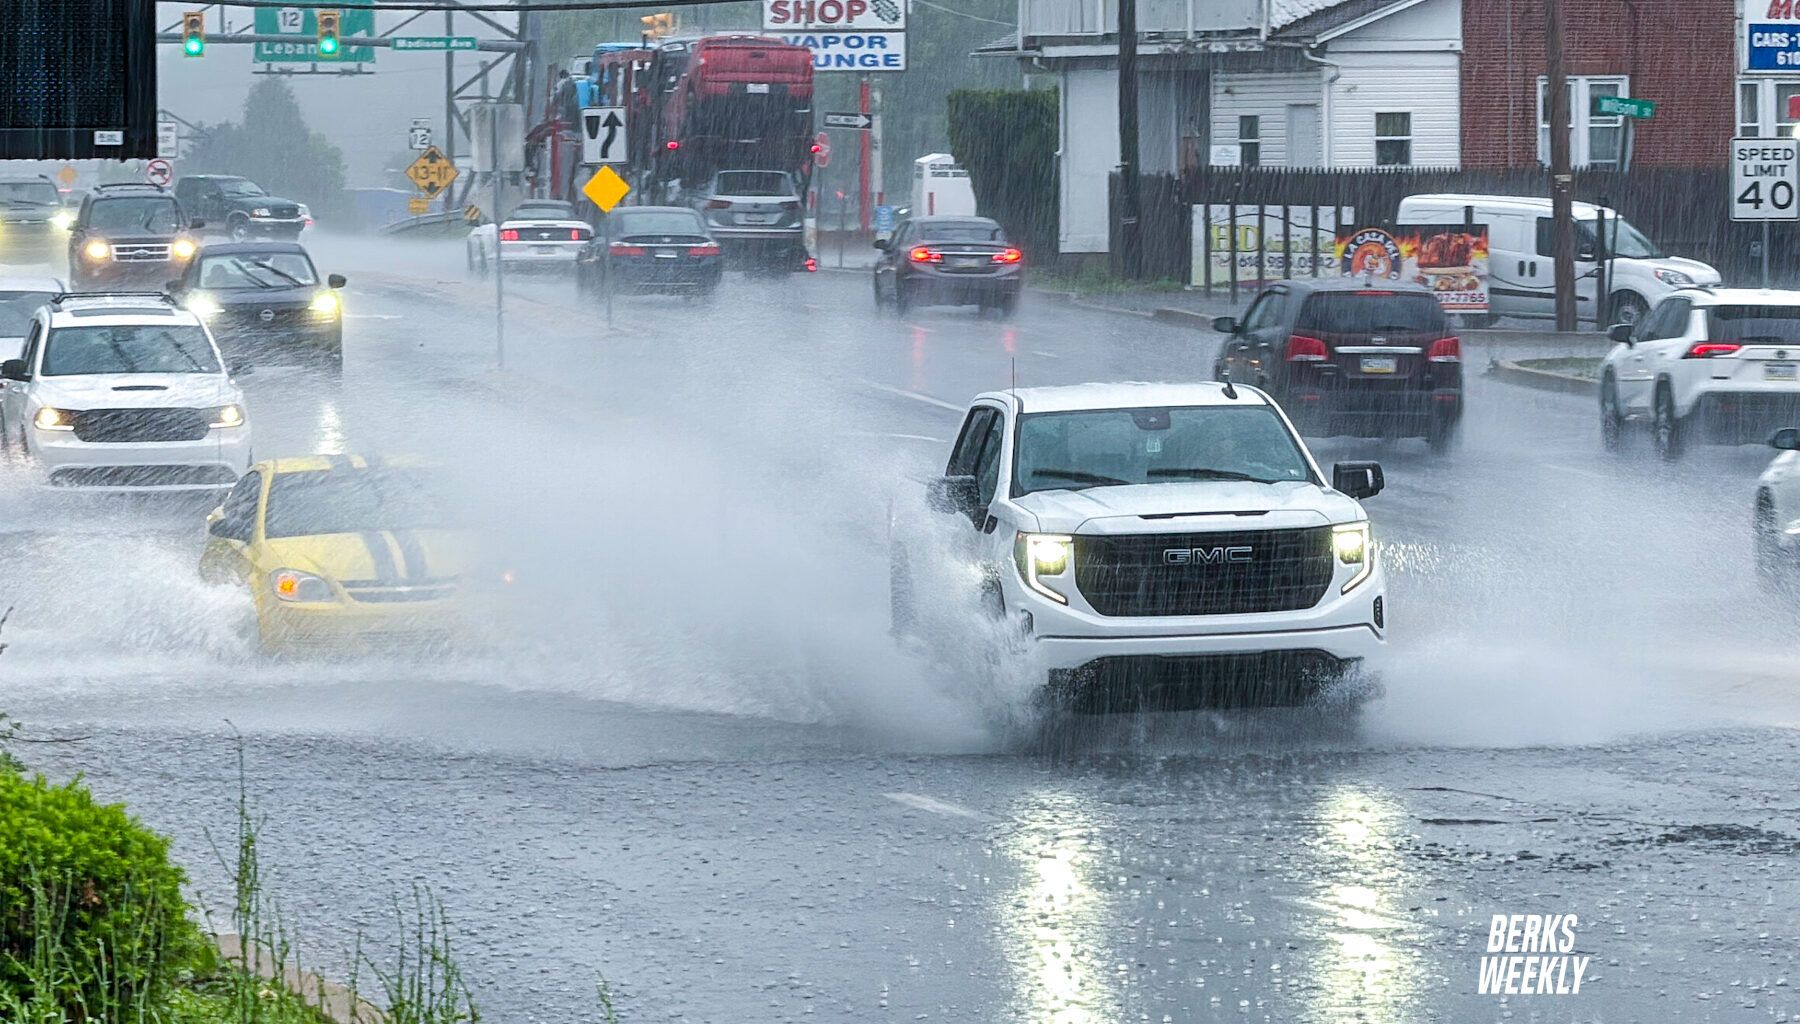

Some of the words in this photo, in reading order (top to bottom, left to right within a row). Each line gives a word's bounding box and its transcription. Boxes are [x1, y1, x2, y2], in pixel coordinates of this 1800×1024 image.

[770, 0, 867, 24] SHOP
[281, 12, 299, 27] 12
[263, 43, 319, 55] Leban
[782, 35, 888, 49] VAPOR
[811, 53, 902, 68] UNGE
[413, 133, 428, 146] 12
[1737, 148, 1795, 161] SPEED
[1743, 164, 1788, 177] LIMIT
[1737, 181, 1794, 210] 40
[1163, 546, 1252, 565] GMC
